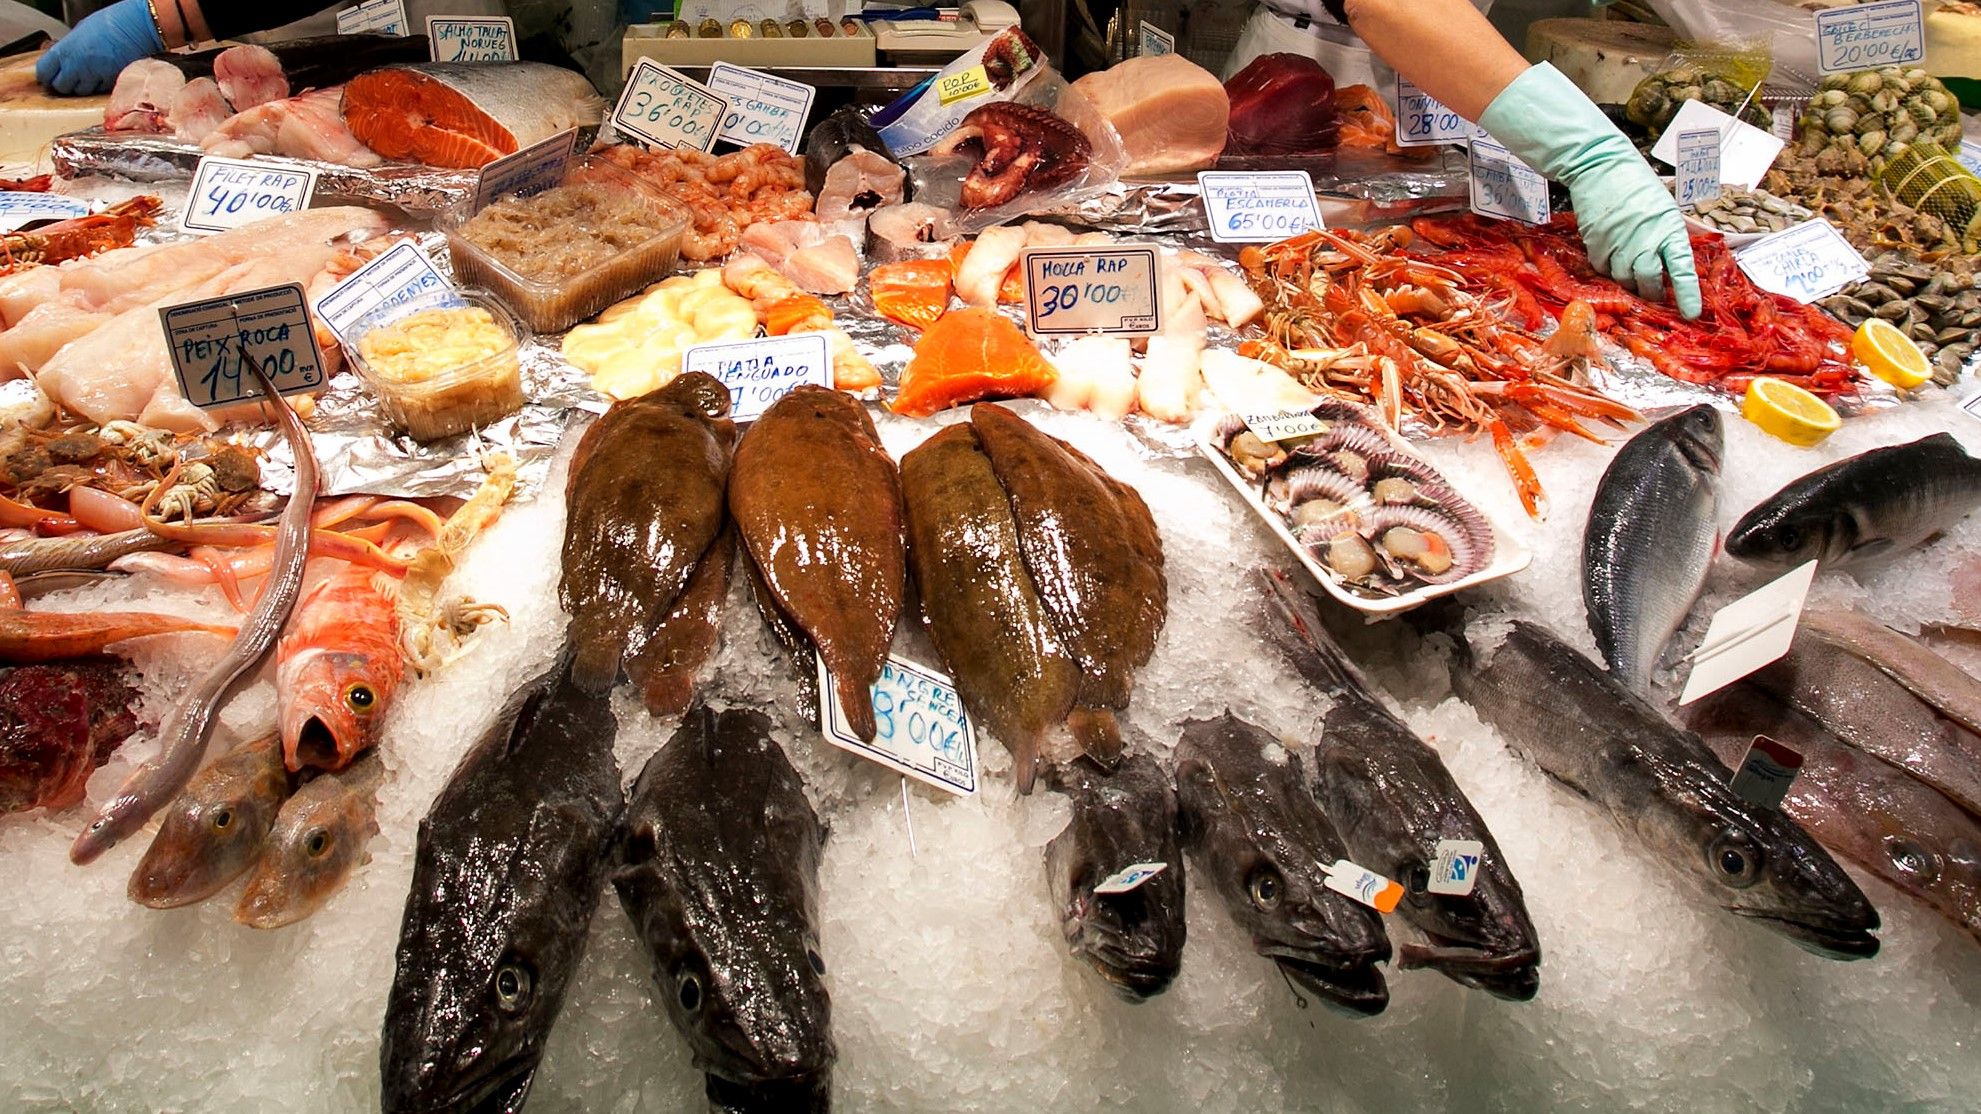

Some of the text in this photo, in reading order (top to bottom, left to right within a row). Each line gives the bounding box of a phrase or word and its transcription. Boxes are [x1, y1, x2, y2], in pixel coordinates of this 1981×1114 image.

[943, 72, 970, 91] POP
[674, 97, 701, 117] RAP
[896, 117, 960, 156] ulpo cocido
[208, 167, 296, 190] FILET RAP
[1097, 258, 1128, 273] RAP
[184, 322, 290, 364] PEIX ROCA
